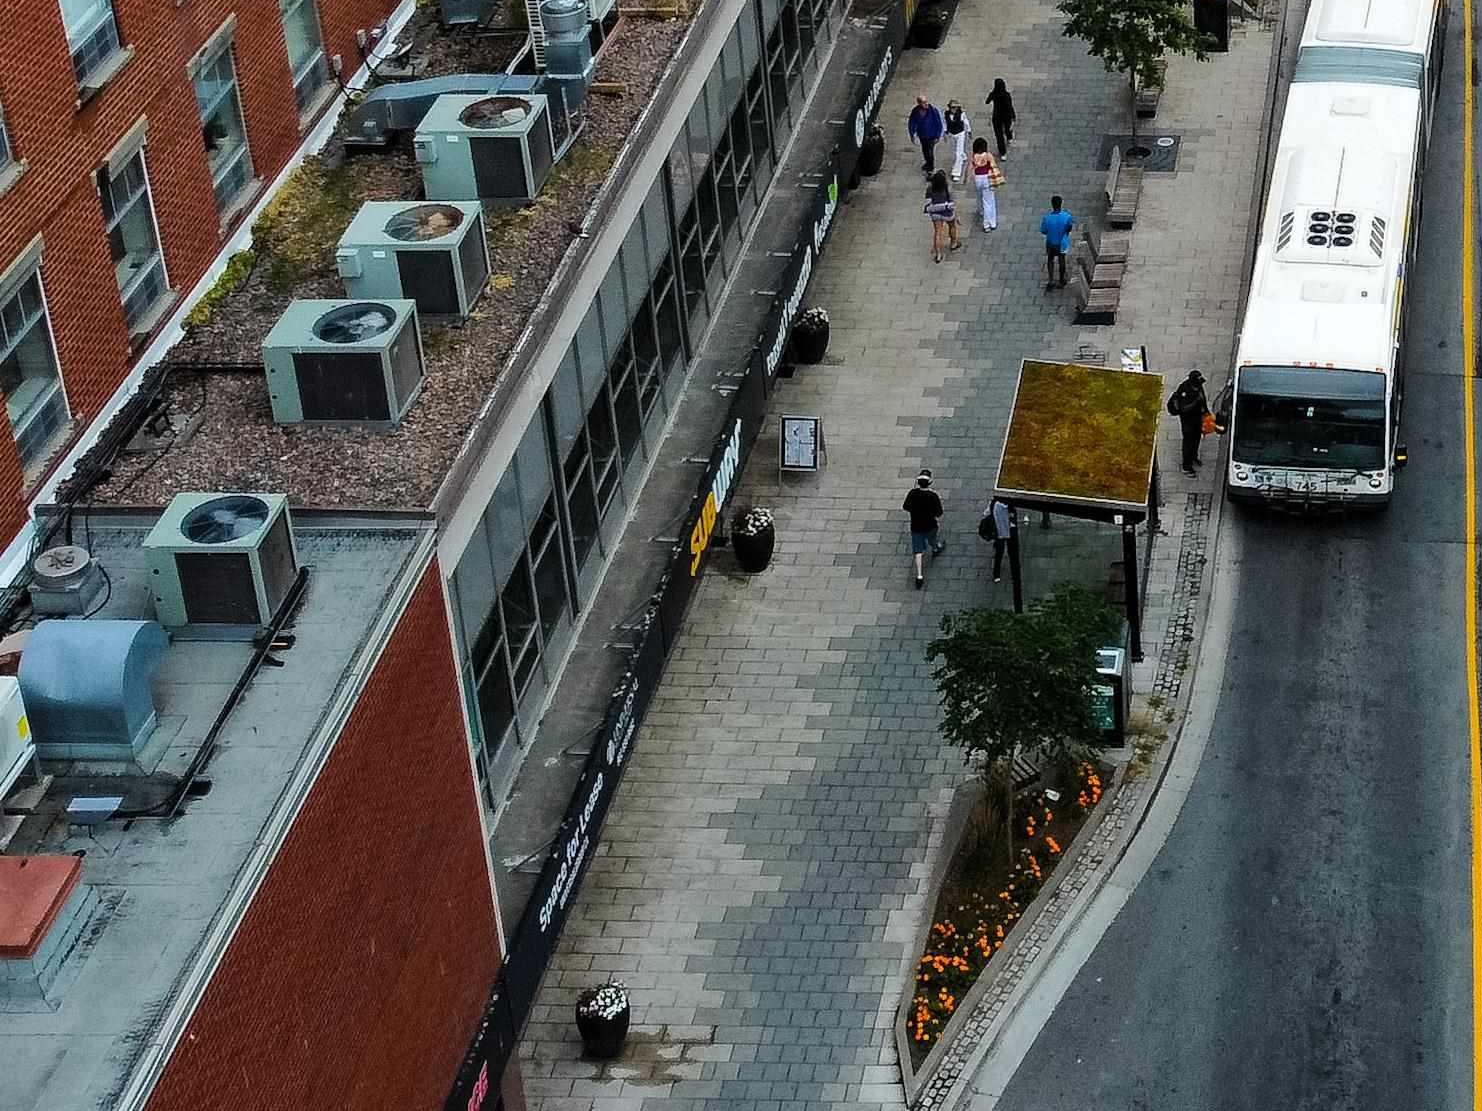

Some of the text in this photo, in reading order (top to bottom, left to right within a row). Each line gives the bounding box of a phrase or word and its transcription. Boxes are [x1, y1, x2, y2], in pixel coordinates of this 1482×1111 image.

[690, 418, 742, 577] SUBWAY
[1296, 481, 1318, 491] 745
[538, 861, 568, 933] Space
[565, 828, 581, 867] for
[579, 772, 604, 836] Lease
